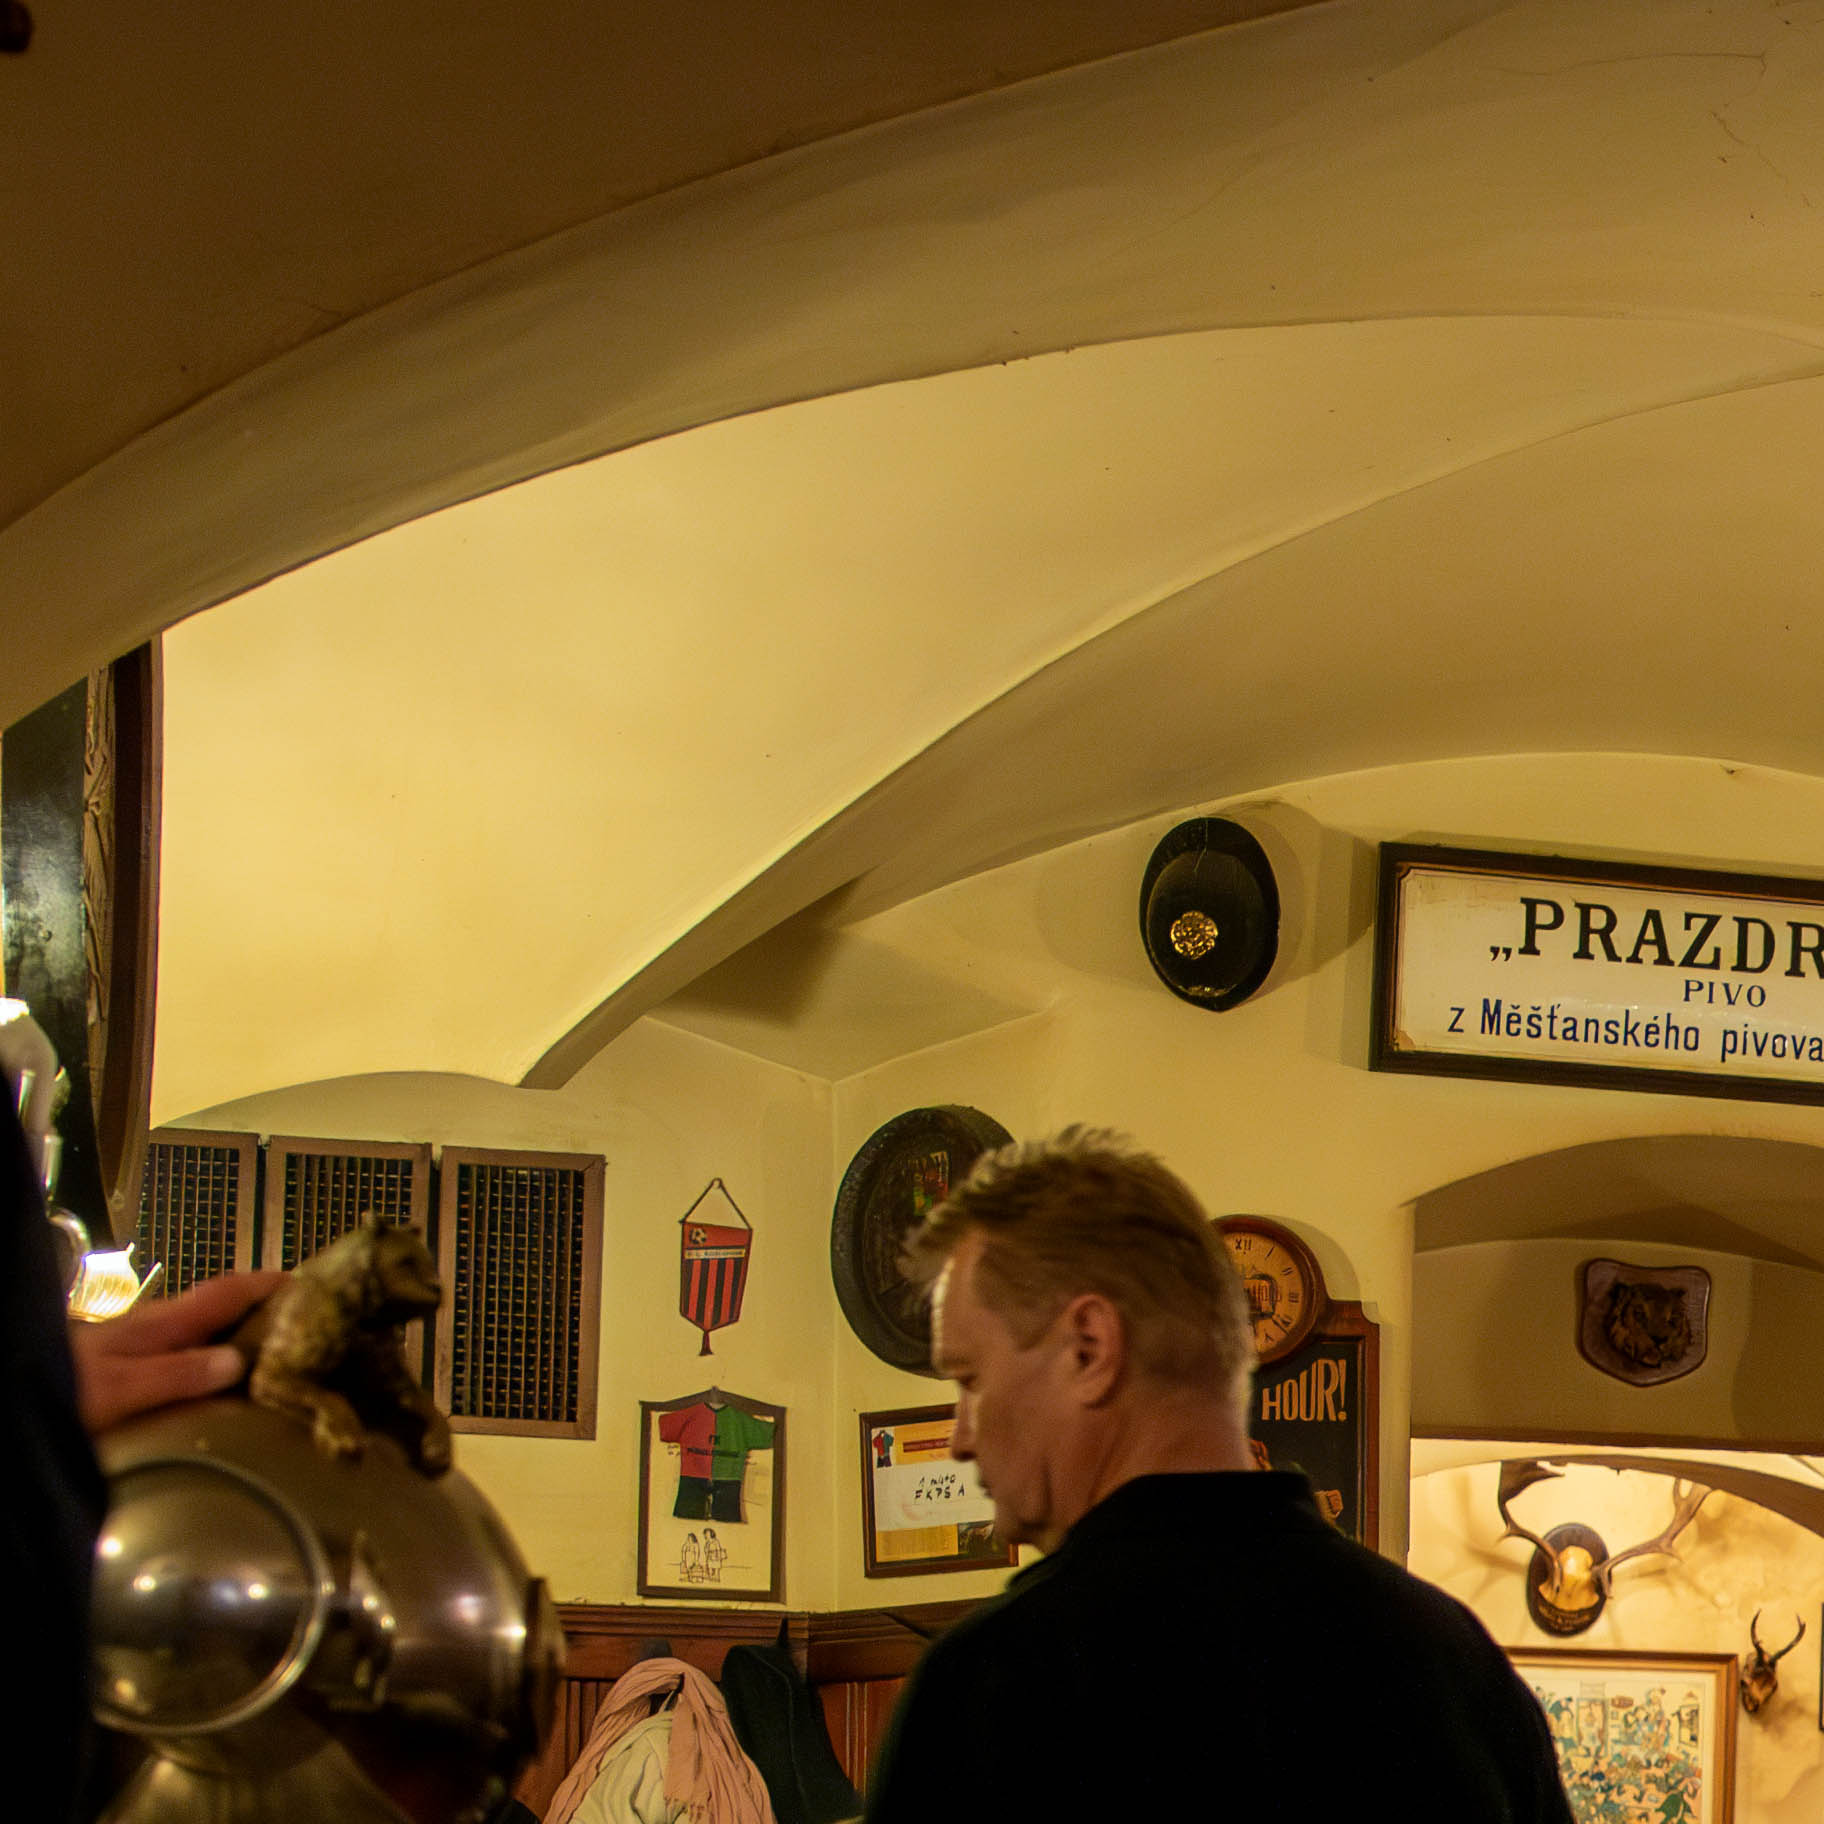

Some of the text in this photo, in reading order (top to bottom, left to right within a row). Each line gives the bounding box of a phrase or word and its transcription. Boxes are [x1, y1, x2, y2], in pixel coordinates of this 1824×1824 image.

[1683, 979, 1767, 1008] PIVO
[1447, 1007, 1466, 1034] z
[1480, 998, 1700, 1052] Měšťanského
[1261, 1358, 1347, 1423] HOUR!
